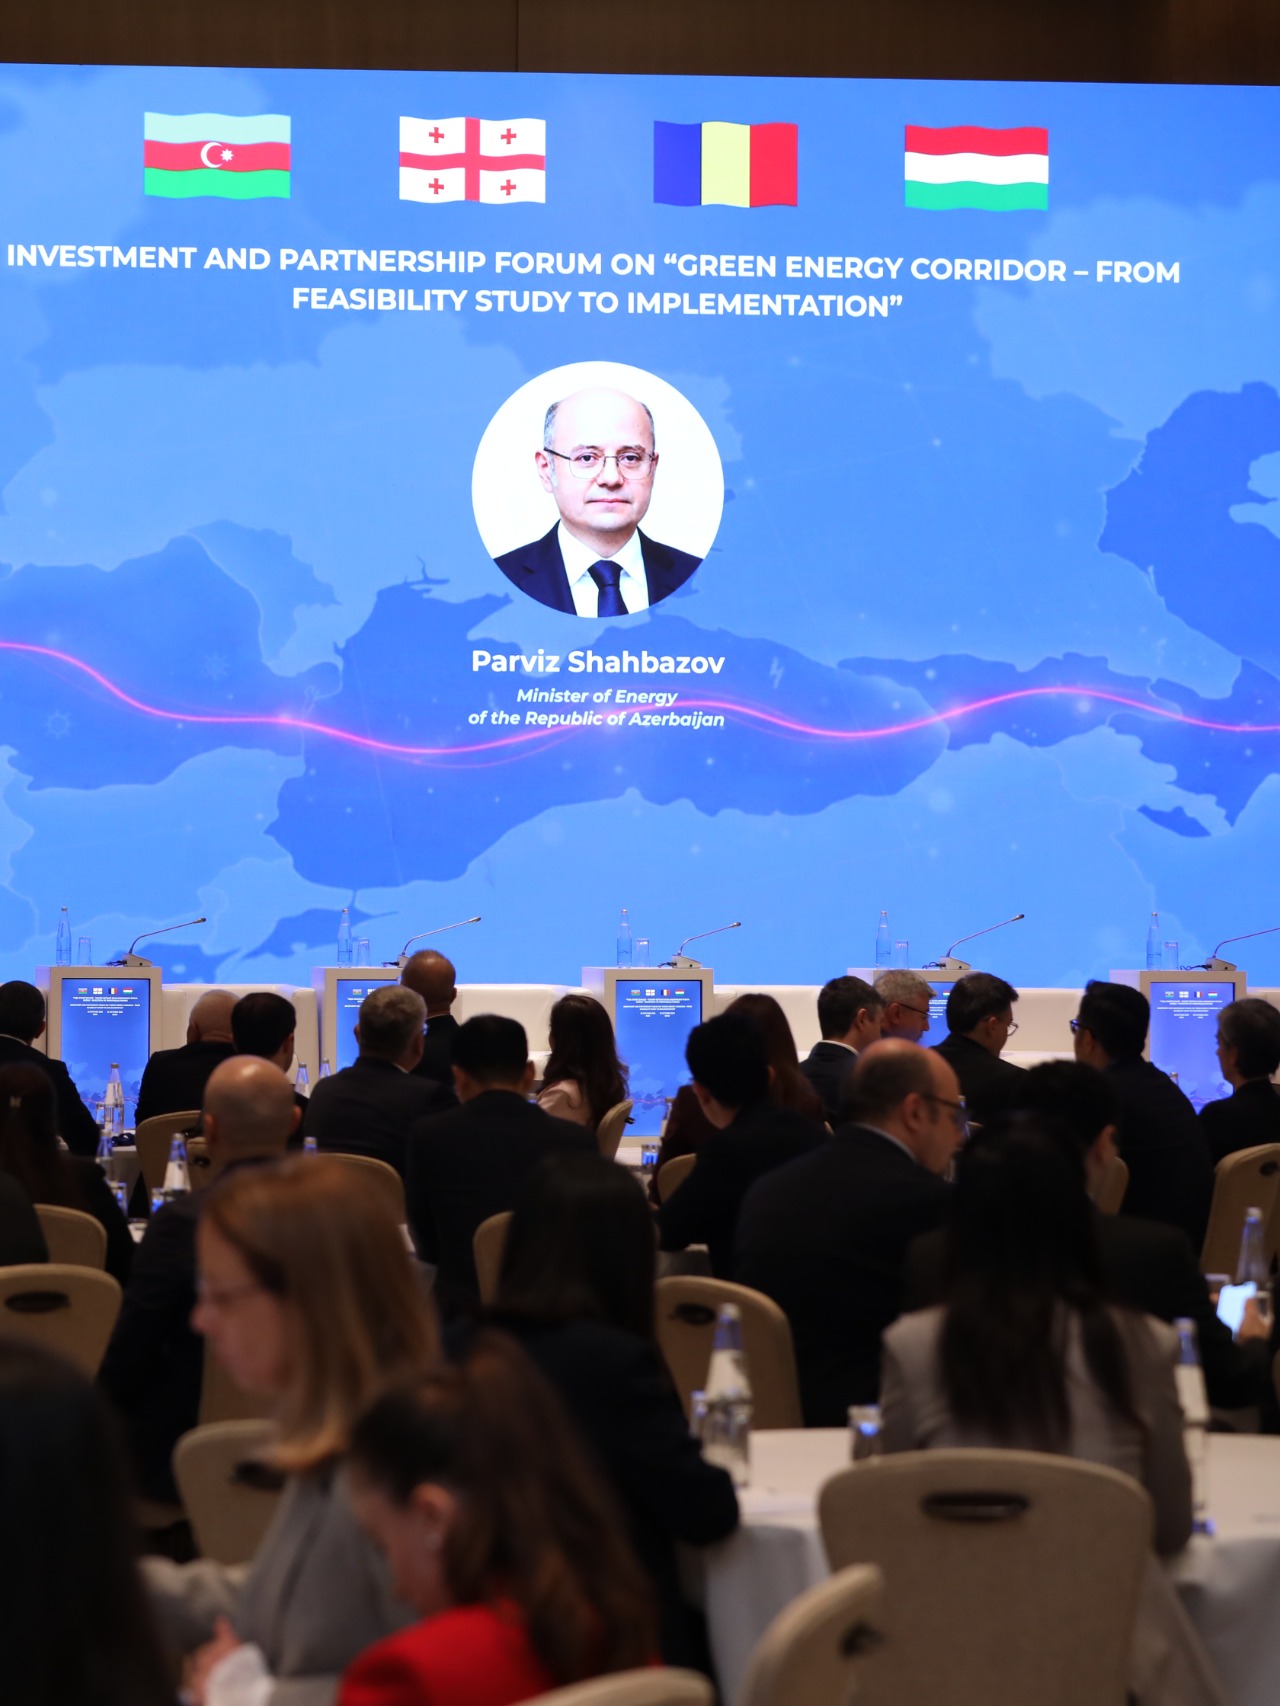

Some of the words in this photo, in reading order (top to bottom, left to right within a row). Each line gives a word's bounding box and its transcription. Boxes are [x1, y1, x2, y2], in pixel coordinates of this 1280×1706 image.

[7, 244, 198, 269] INVESTMENT
[203, 247, 271, 270] AND
[280, 248, 486, 273] PARTNERSHIP
[495, 251, 602, 275] FORUM
[610, 253, 655, 276] ON
[786, 256, 904, 279] ENERGY
[910, 257, 1067, 282] CORRIDOR
[1096, 260, 1180, 284] FROM
[293, 287, 468, 311] FEASIBILITY
[475, 289, 572, 313] STUDY
[578, 291, 619, 314] TO
[472, 648, 560, 673] Parviz
[568, 650, 725, 674] Shahbazov
[516, 687, 589, 703] Minister
[592, 688, 613, 703] of
[614, 689, 679, 707] Energy
[467, 710, 488, 725] of
[490, 710, 521, 725] the
[524, 710, 604, 728] Republic
[606, 711, 627, 726] of
[627, 711, 725, 730] Azerbaijan
